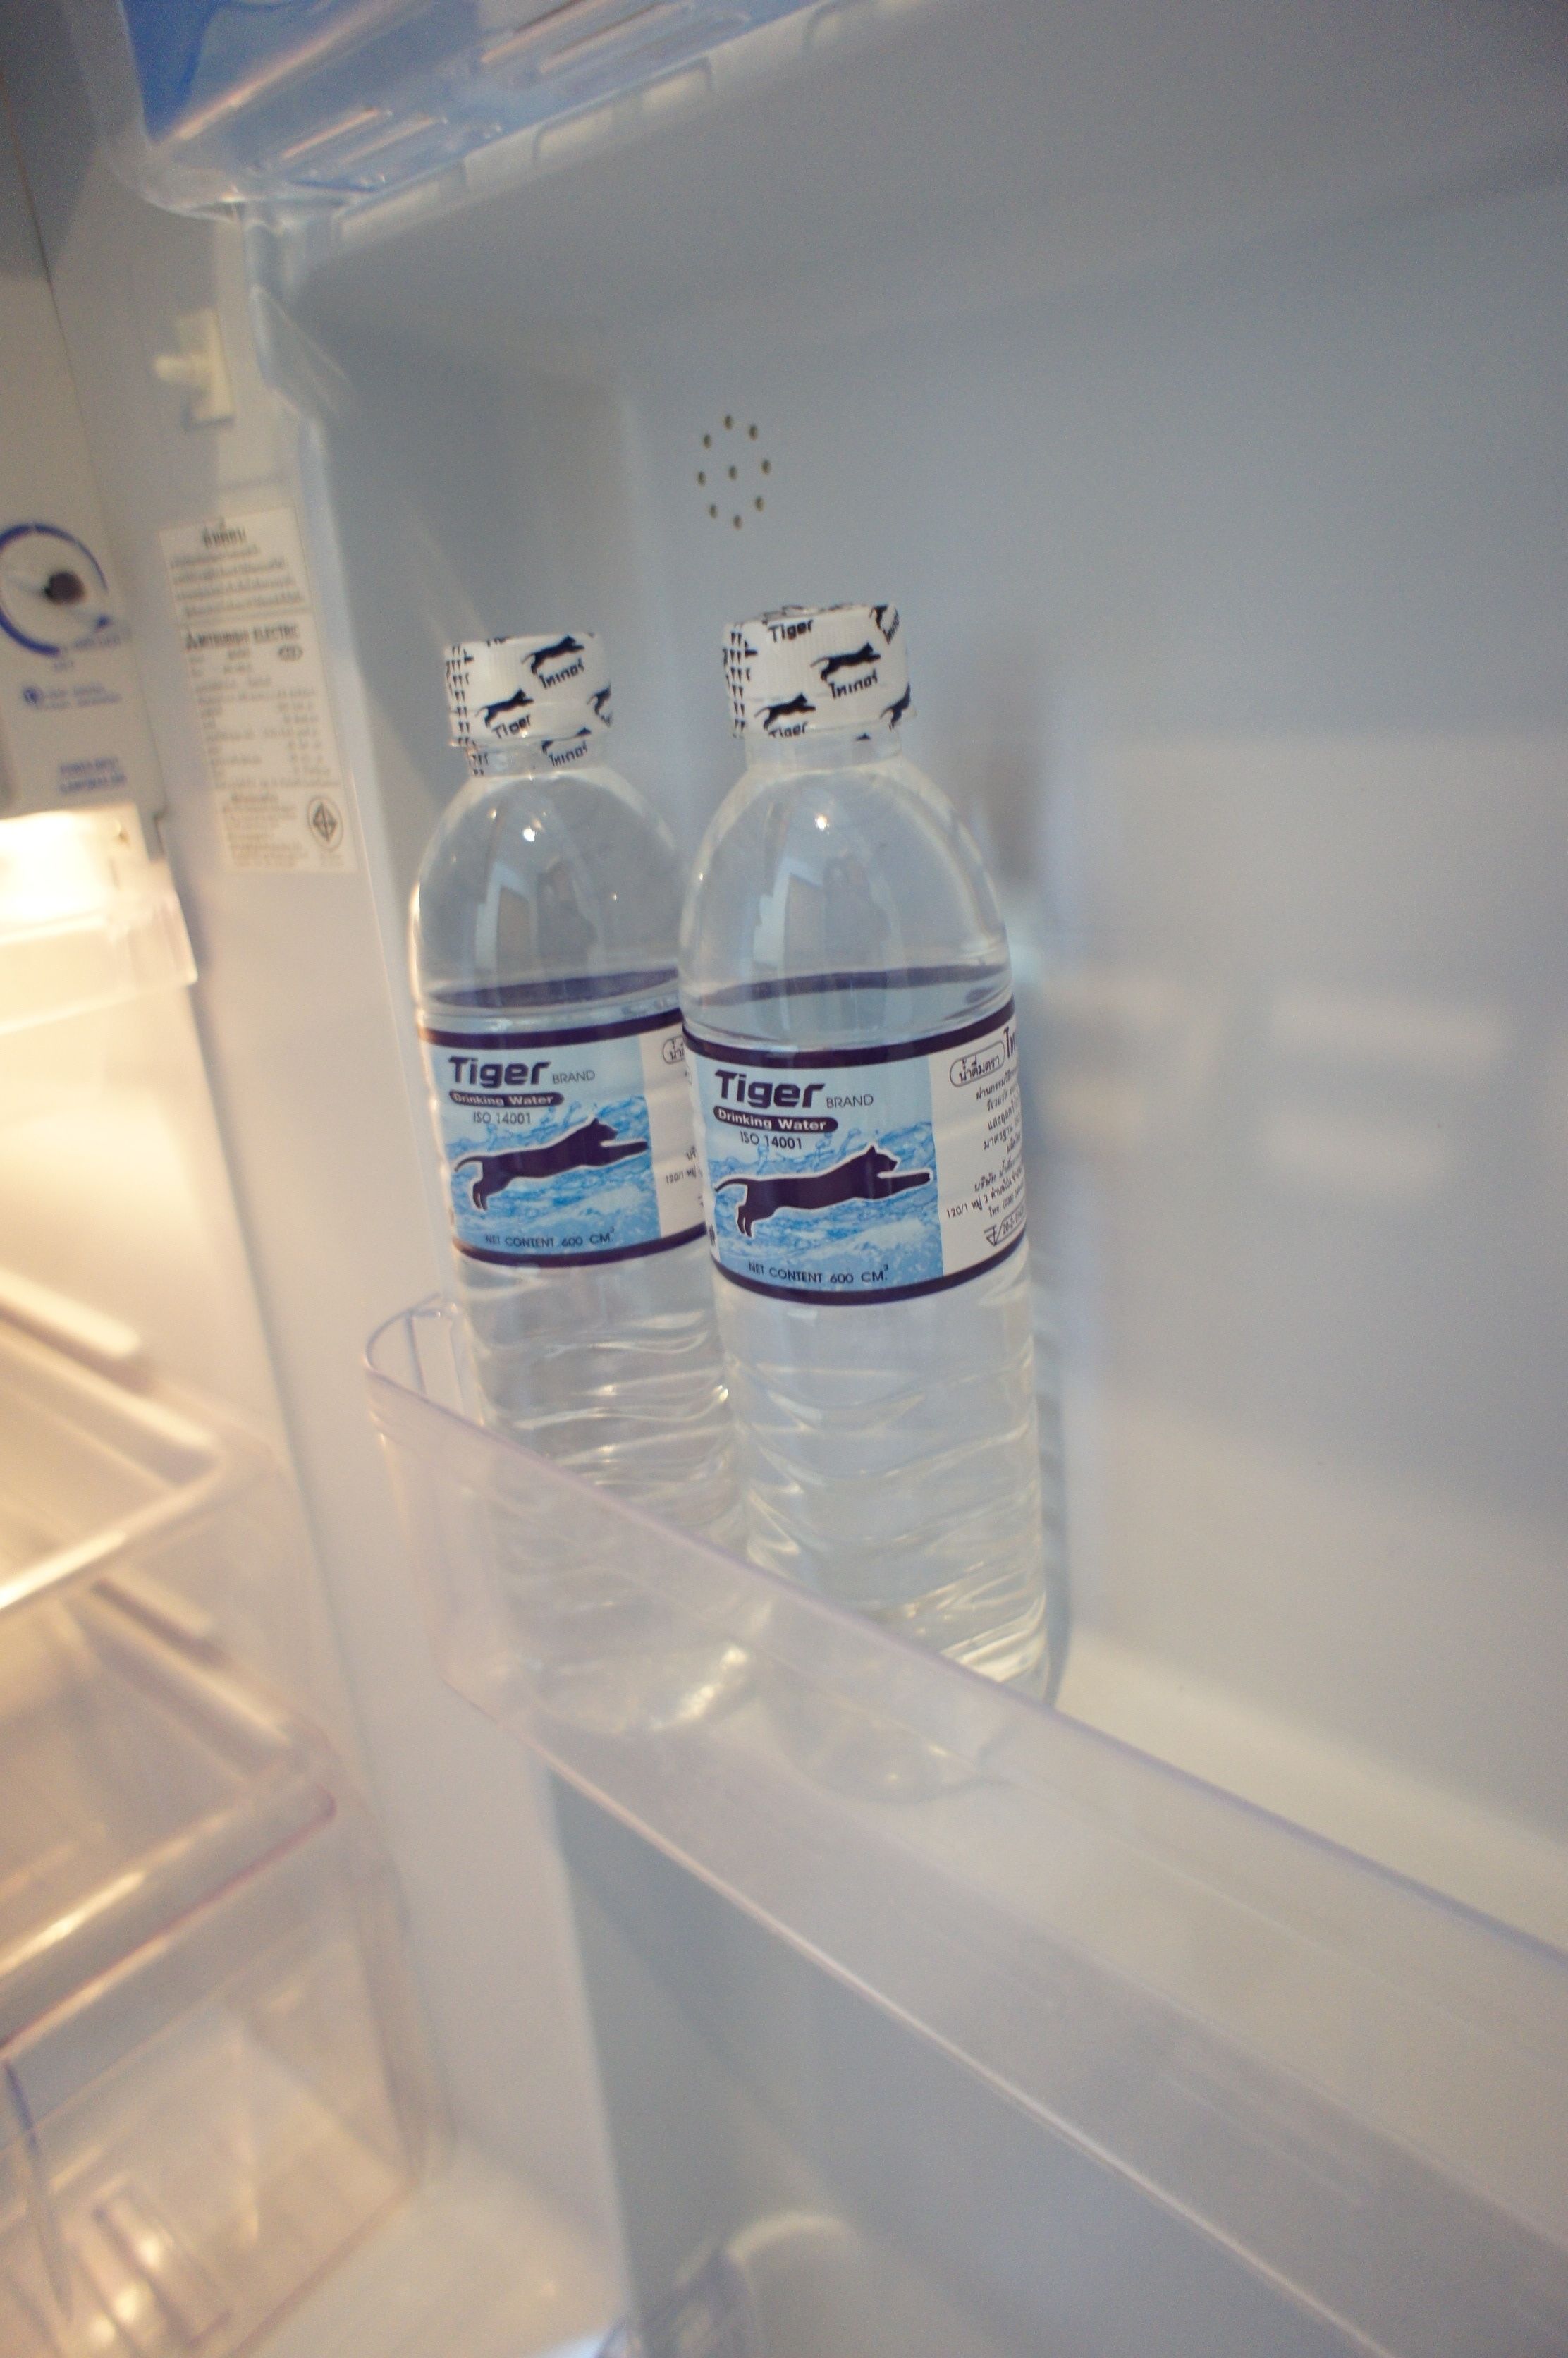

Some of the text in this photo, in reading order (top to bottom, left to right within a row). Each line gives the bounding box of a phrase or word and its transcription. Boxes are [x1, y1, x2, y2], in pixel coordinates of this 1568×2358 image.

[768, 619, 813, 643] Tiger
[491, 714, 531, 738] Tiger
[448, 1056, 596, 1089] Tiger BRAND
[958, 1055, 1000, 1082] น้ำดื่มตรา
[715, 1069, 874, 1109] Tiger BRAND
[453, 1094, 554, 1107] Drinking Water
[473, 1112, 531, 1125] ISO 14001
[718, 1108, 828, 1131] Drinking Water
[740, 1131, 802, 1149] ISO 14001
[946, 1202, 968, 1219] 120/1
[484, 1234, 501, 1245] NET
[504, 1237, 554, 1248] CONTENT
[561, 1236, 584, 1247] 600
[748, 1262, 764, 1276] NET
[769, 1267, 822, 1283] CONTENT
[829, 1272, 854, 1284] 600
